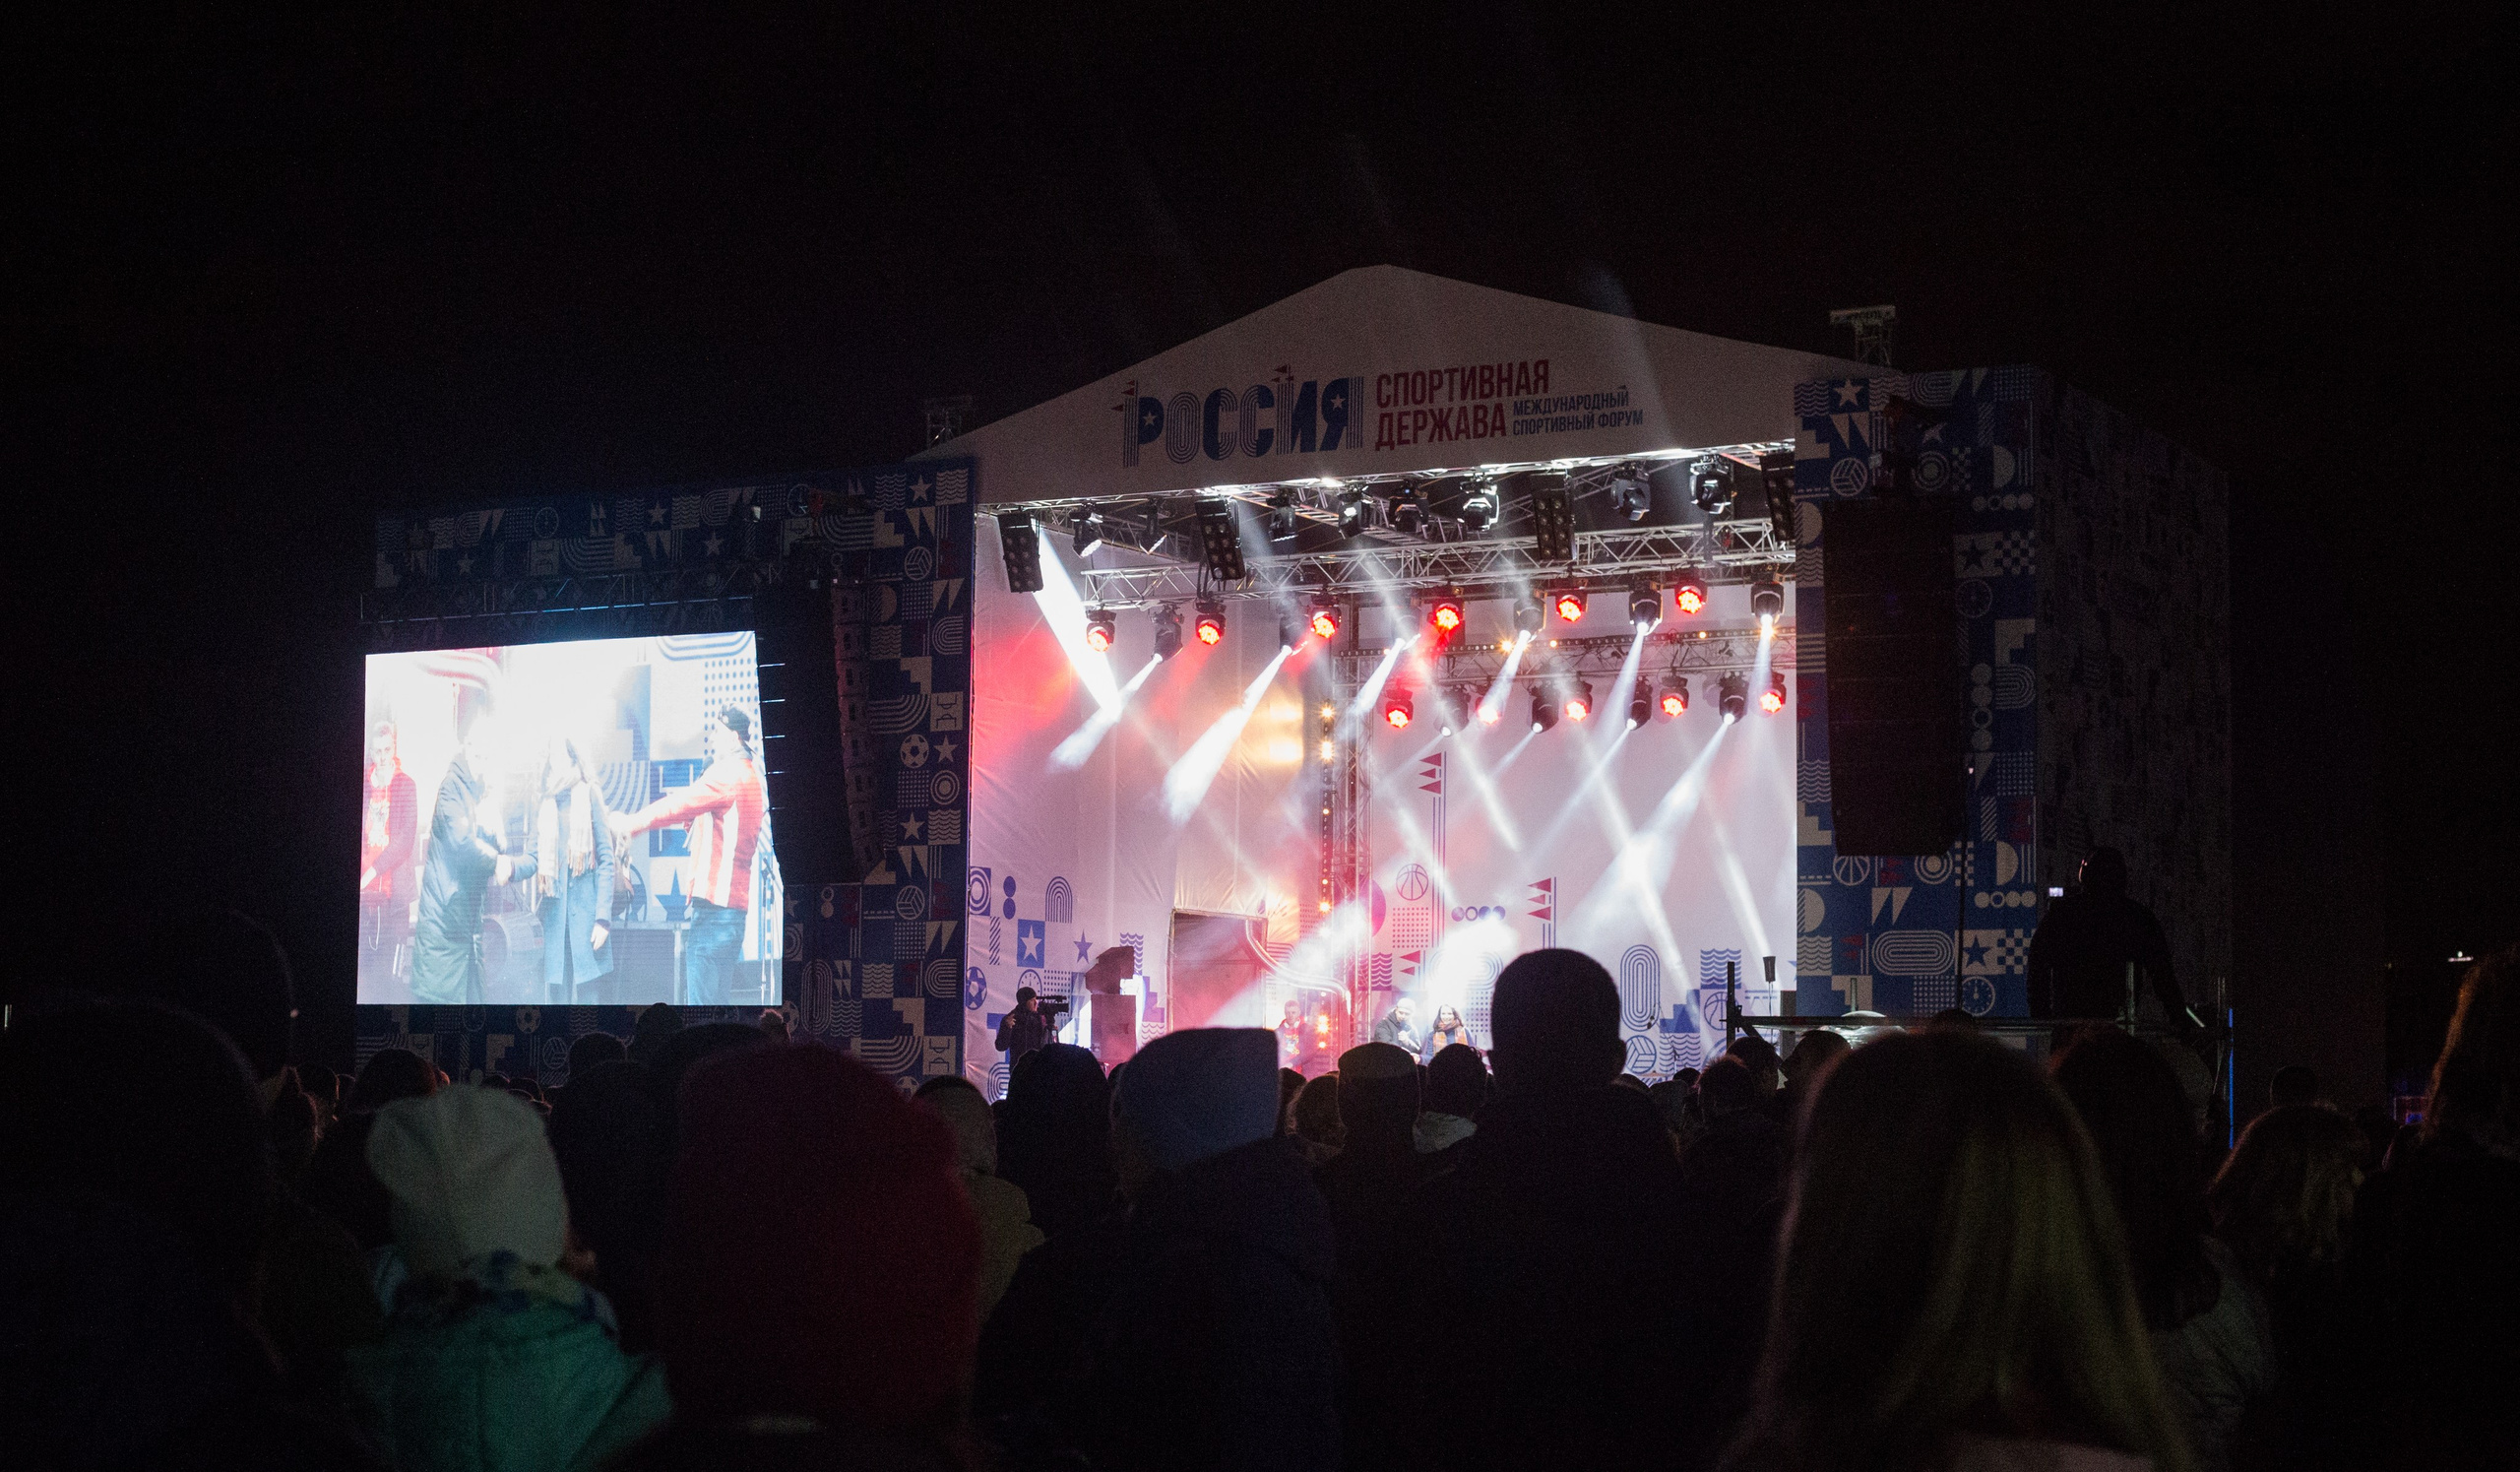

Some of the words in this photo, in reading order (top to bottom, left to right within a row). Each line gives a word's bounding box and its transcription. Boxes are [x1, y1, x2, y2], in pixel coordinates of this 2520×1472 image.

[1377, 359, 1549, 409] СПОРТИВНАЯ
[1513, 387, 1629, 416] МЕЖДУНАРОДНЫЙ
[1123, 377, 1364, 467] РОССИЯ
[1375, 403, 1507, 451] ДЕРЖАВА
[1513, 411, 1595, 436] СПОРТИВНЫЙ
[1598, 410, 1644, 431] ФОРУМ
